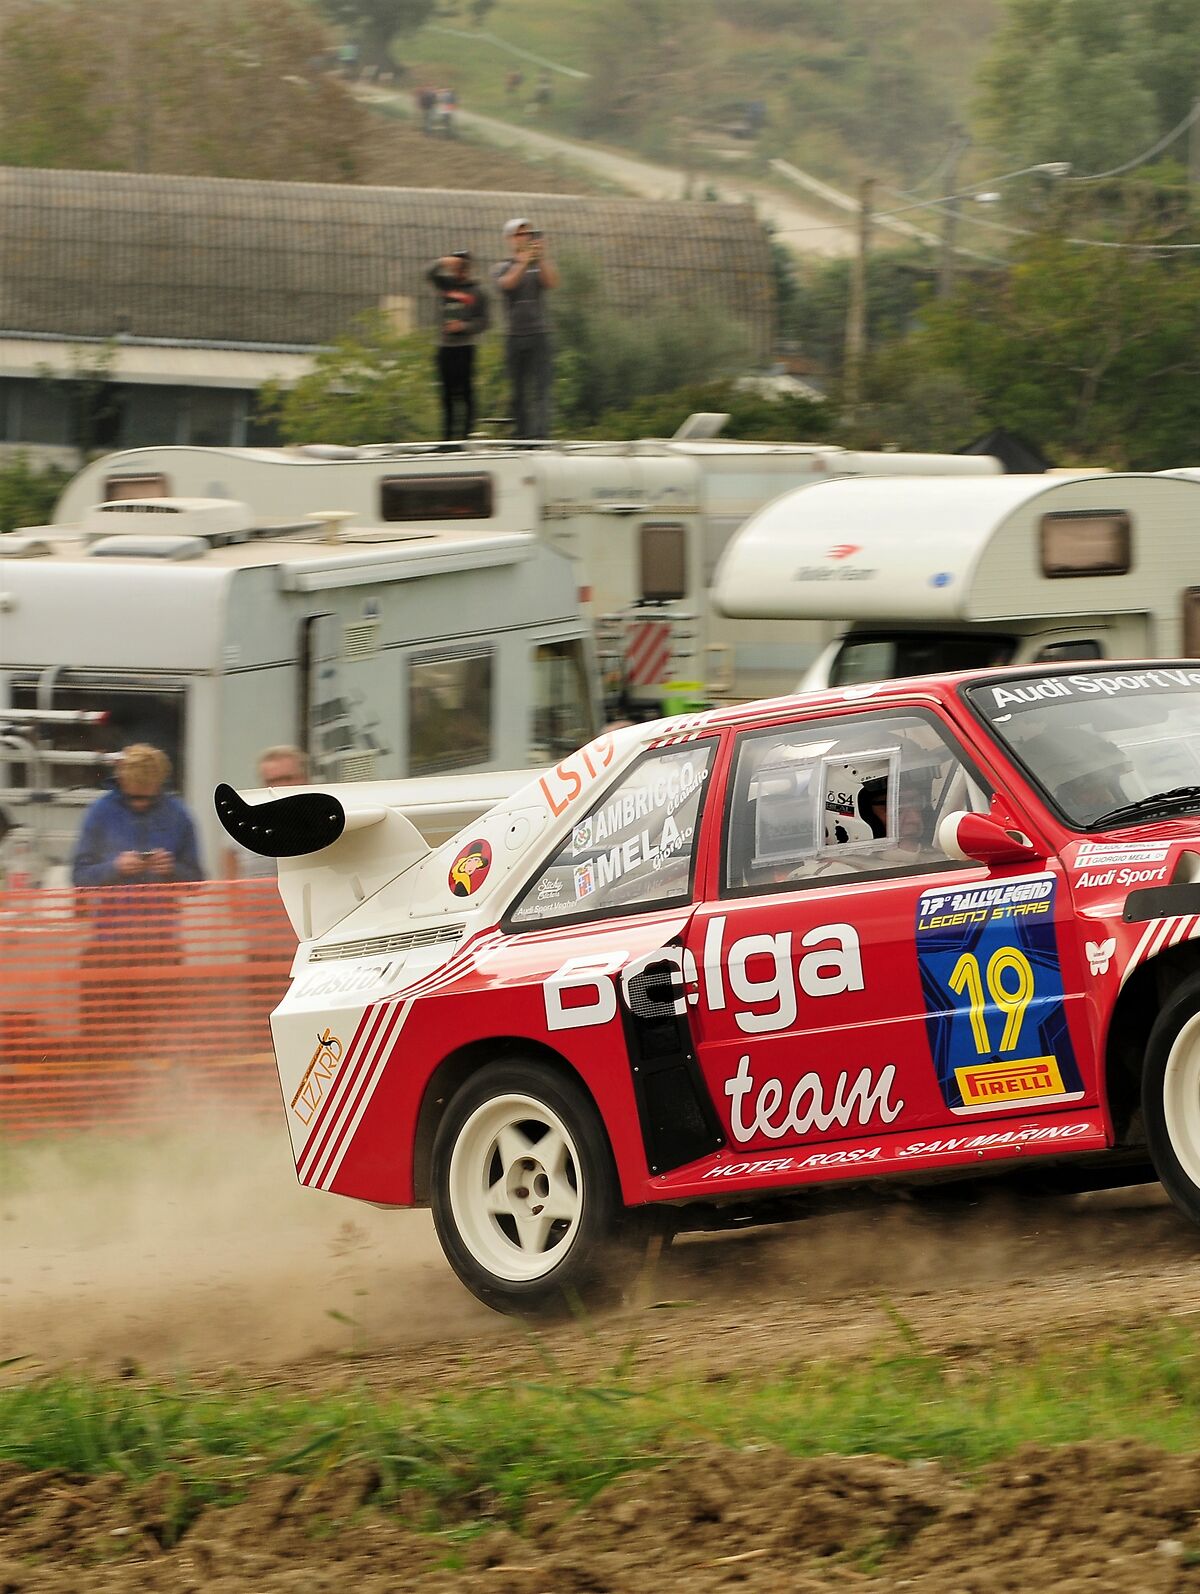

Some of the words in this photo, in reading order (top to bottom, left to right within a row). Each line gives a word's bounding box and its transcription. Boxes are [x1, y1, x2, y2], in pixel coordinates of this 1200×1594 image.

[991, 677, 1073, 708] Audi
[1070, 671, 1170, 695] Sport
[597, 815, 680, 888] MELA
[652, 827, 692, 871] Giorgio
[1075, 869, 1117, 889] Audi
[1116, 865, 1168, 887] Sport
[918, 911, 986, 930] LEGEND
[990, 900, 1051, 920] STARS
[543, 915, 866, 1033] Belga
[948, 945, 1035, 1054] 19
[294, 1036, 344, 1126] LIZARD
[724, 1054, 904, 1143] team
[965, 1064, 1053, 1097] PIRELLI
[701, 1157, 794, 1179] HOTEL
[797, 1147, 883, 1168] ROSA
[898, 1138, 966, 1157] SAN
[966, 1123, 1091, 1148] MARINO
